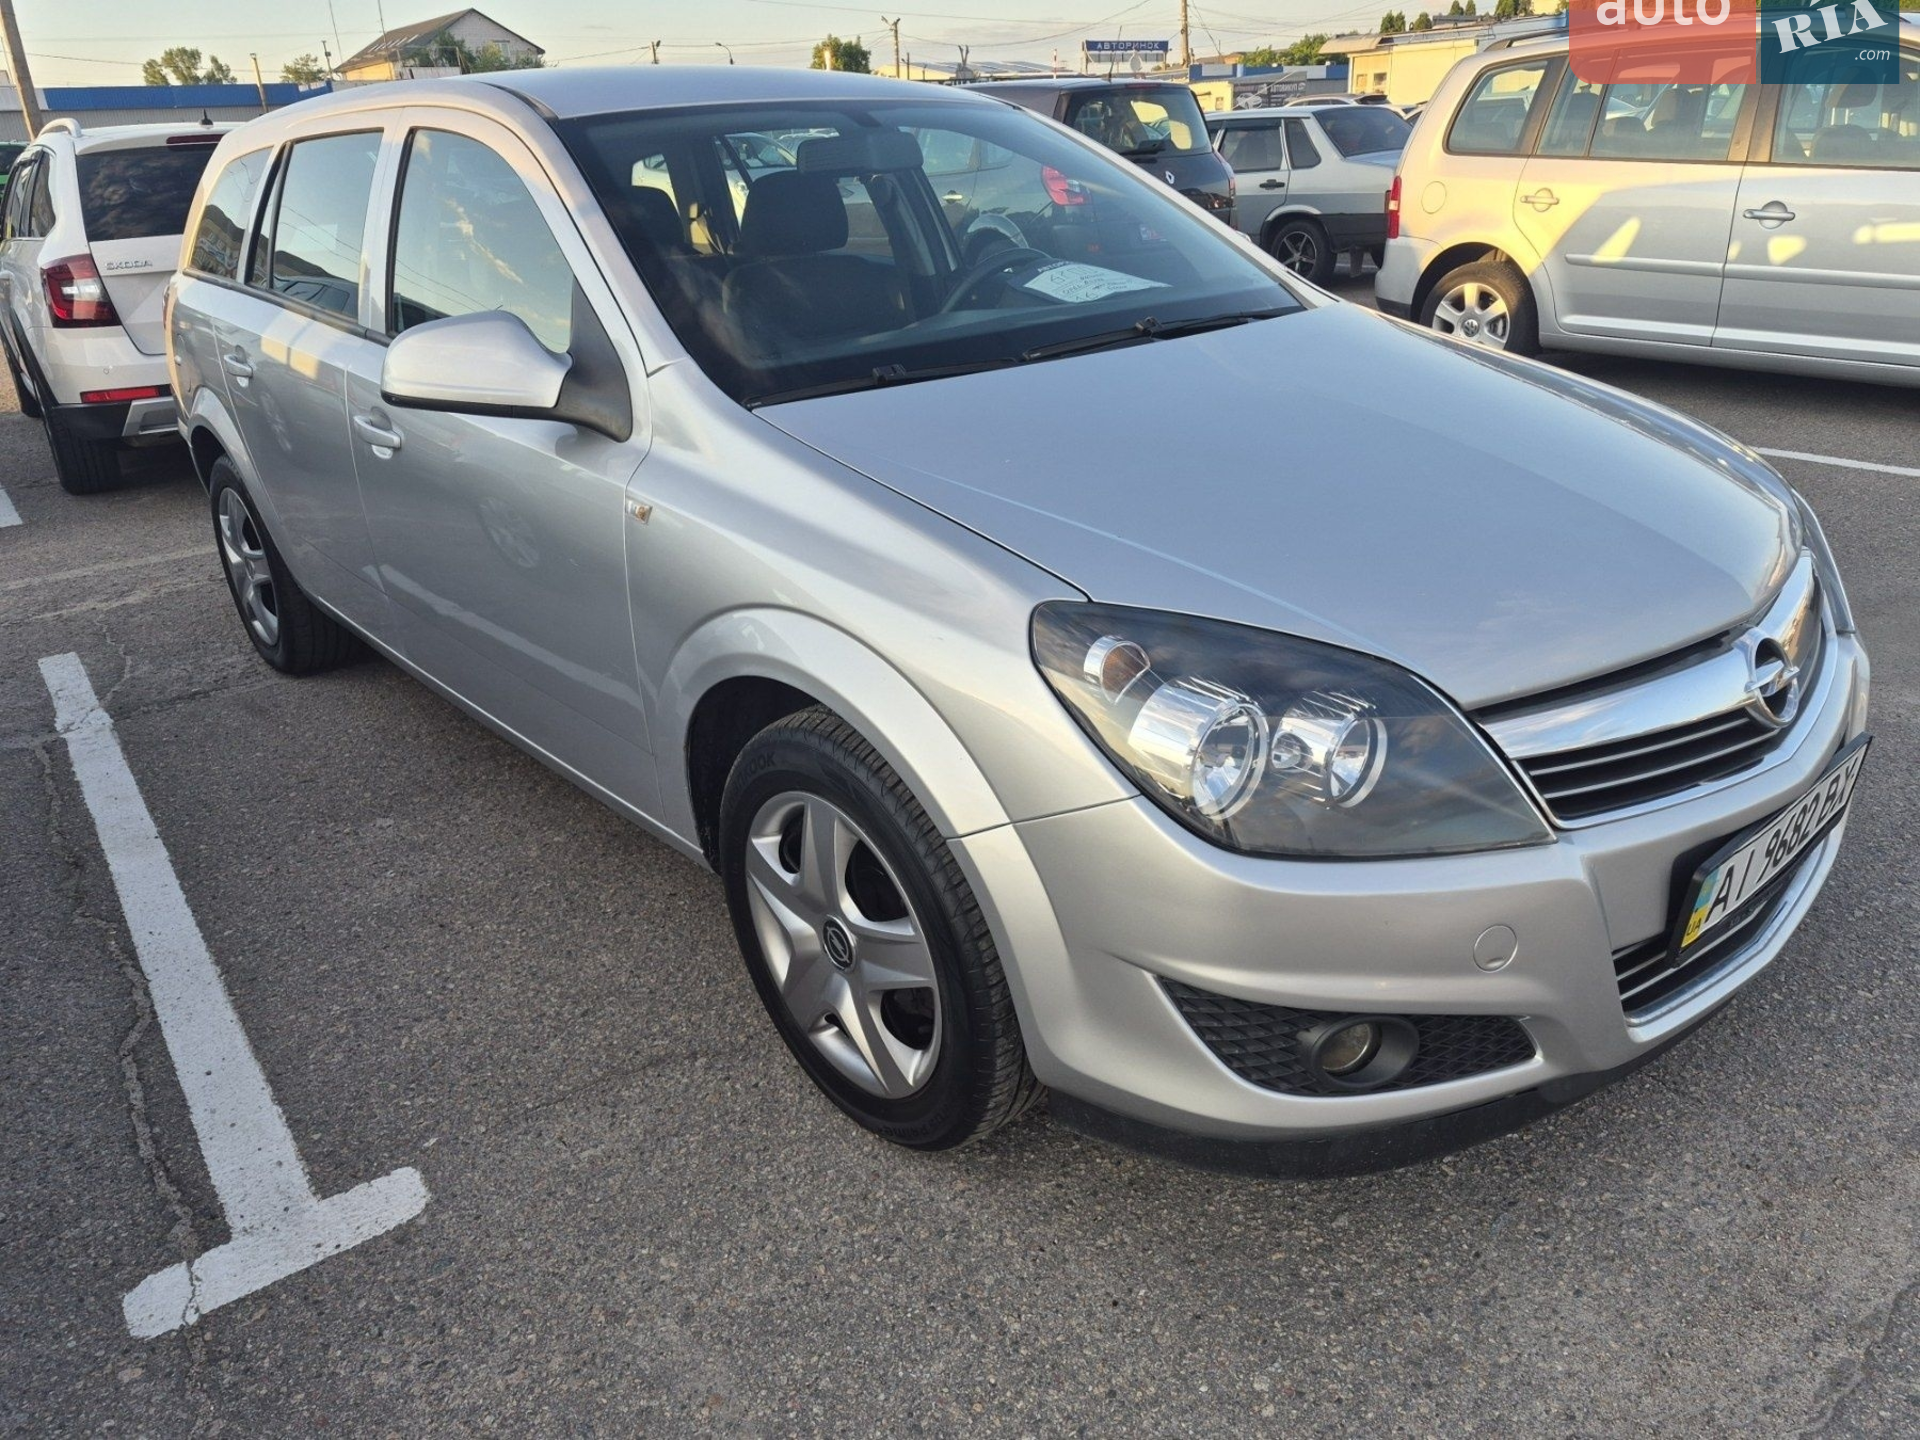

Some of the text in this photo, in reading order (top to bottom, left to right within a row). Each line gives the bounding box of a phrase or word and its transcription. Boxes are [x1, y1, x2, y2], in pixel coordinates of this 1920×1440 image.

[1096, 42, 1160, 50] АВТОРИНОК
[1704, 849, 1756, 924] AI
[1756, 792, 1821, 884] 9682
